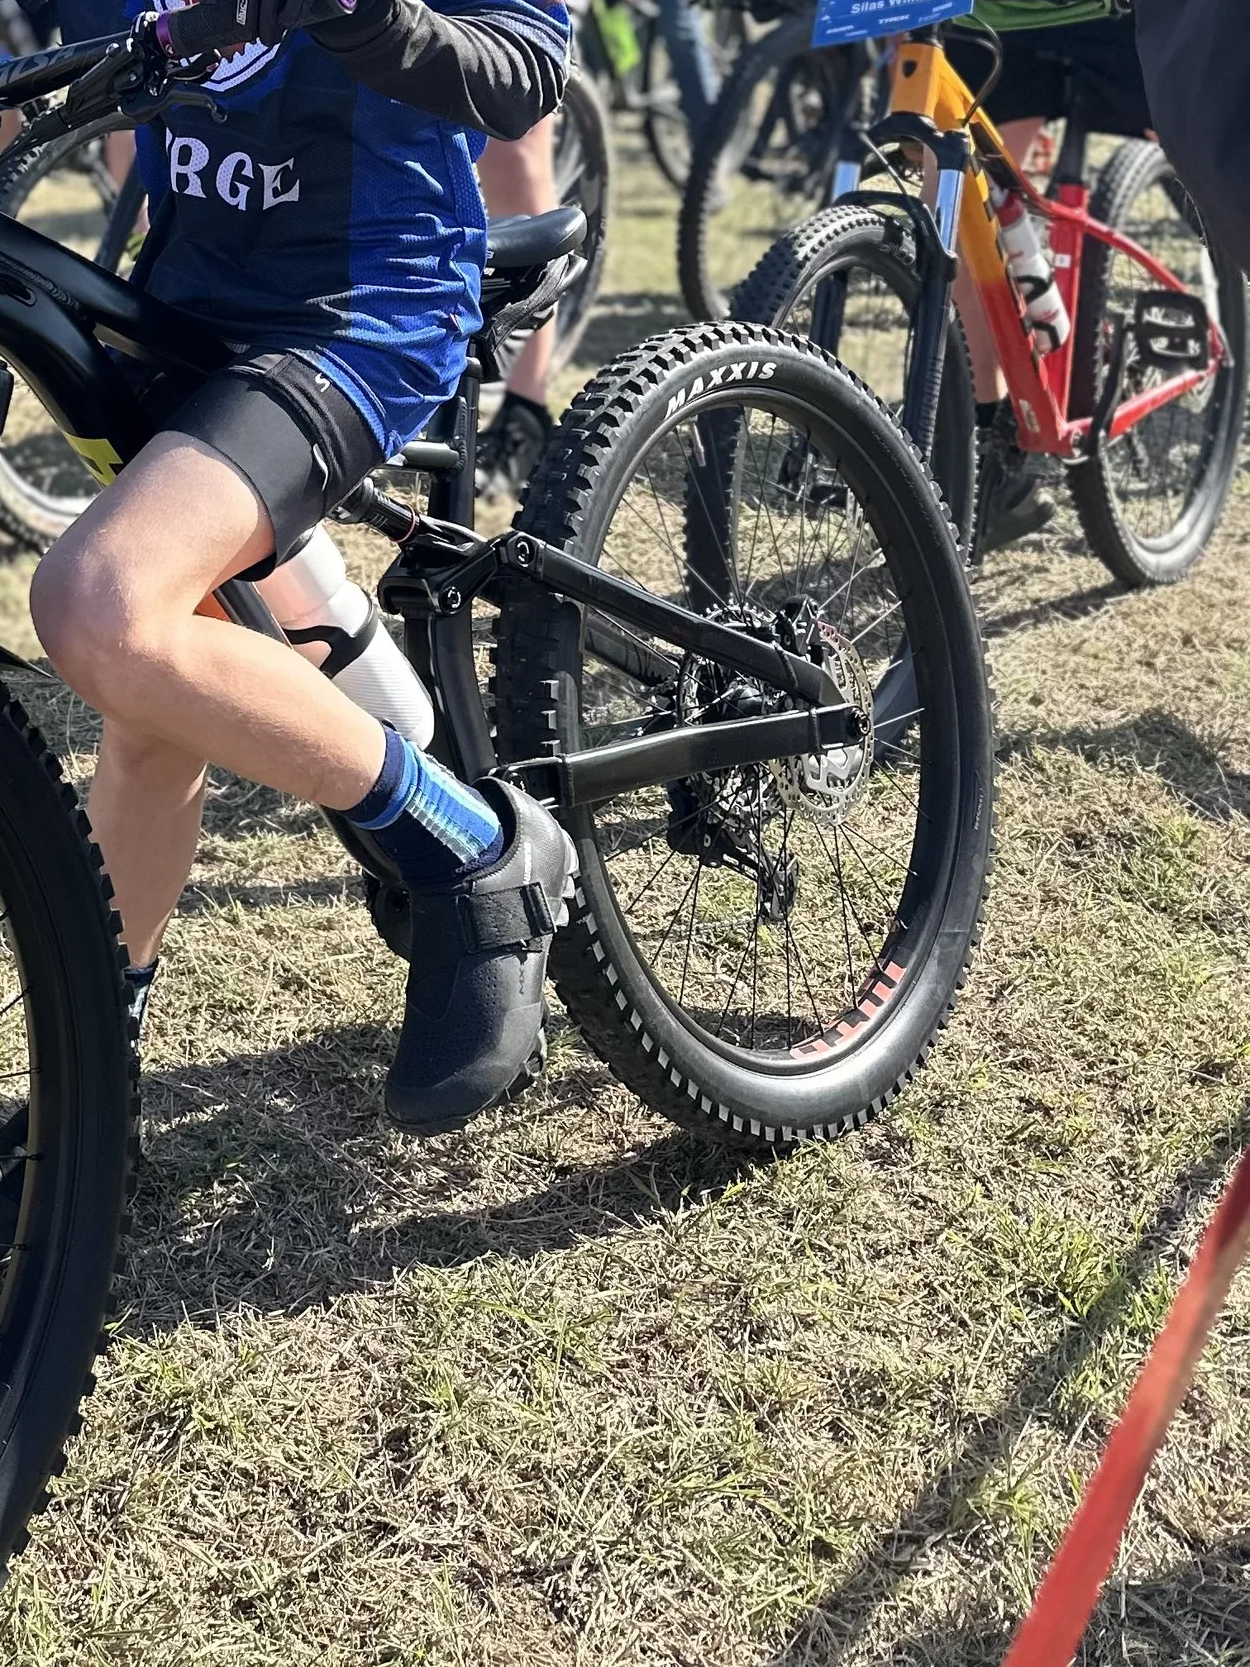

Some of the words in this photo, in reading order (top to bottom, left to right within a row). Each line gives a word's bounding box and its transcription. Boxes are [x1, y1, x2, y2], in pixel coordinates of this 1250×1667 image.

[851, 0, 885, 14] Silas
[166, 127, 299, 211] RGE
[664, 361, 778, 421] MAXXIS
